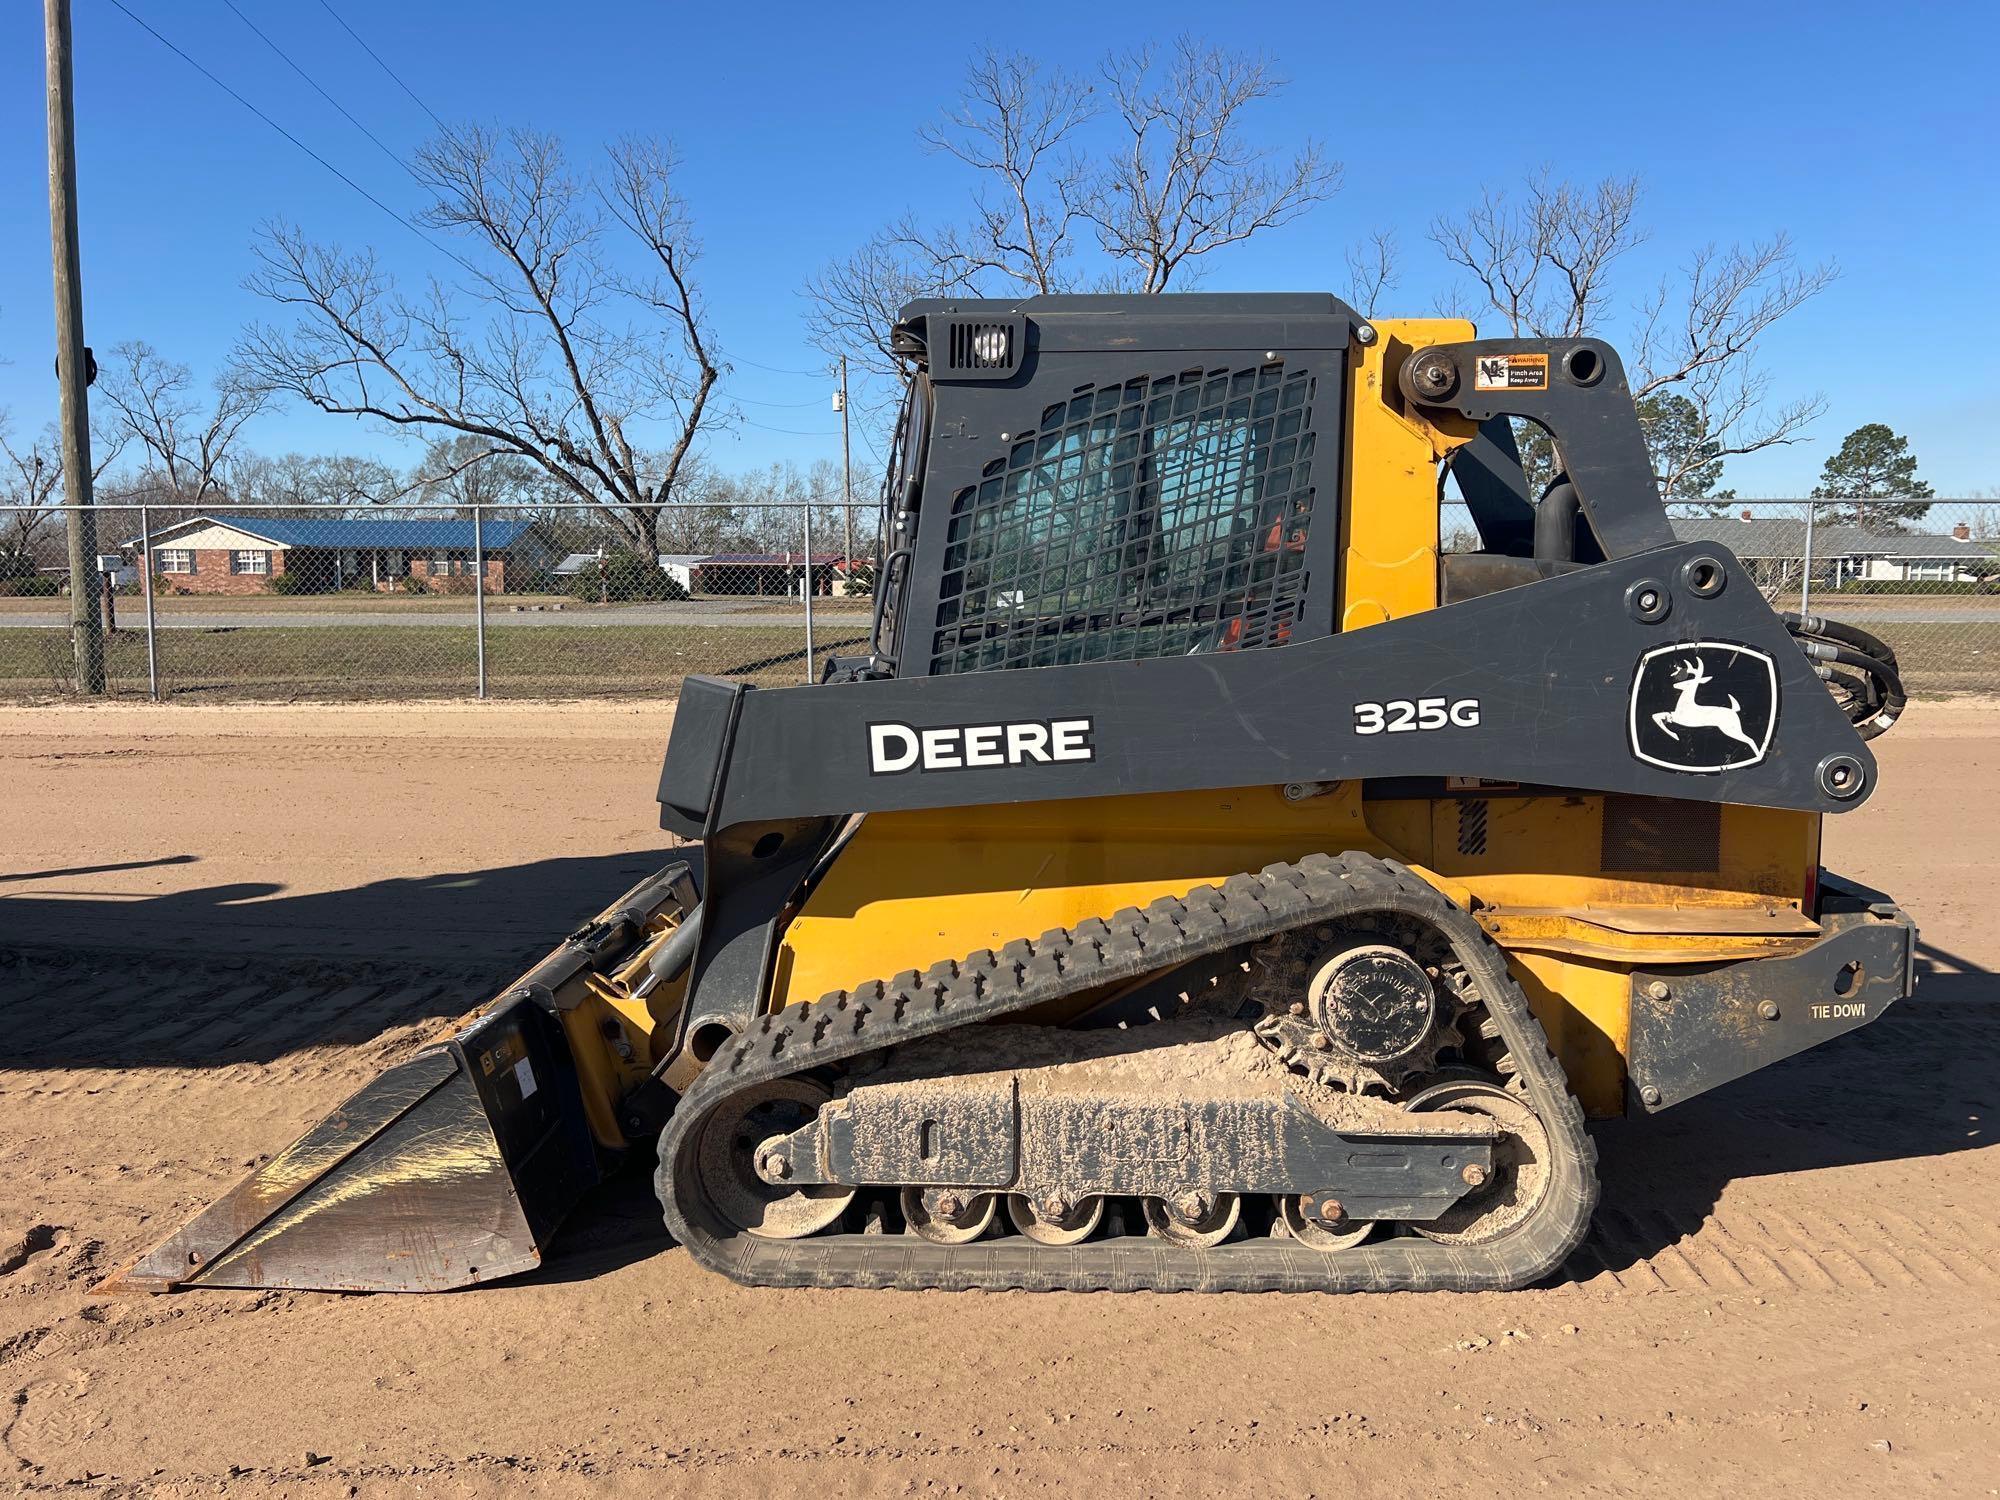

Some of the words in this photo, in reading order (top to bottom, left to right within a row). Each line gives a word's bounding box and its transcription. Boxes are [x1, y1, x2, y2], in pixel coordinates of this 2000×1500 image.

[1354, 698, 1480, 734] 325G
[870, 720, 1092, 773] DEERE
[1811, 1005, 1830, 1019] TIE
